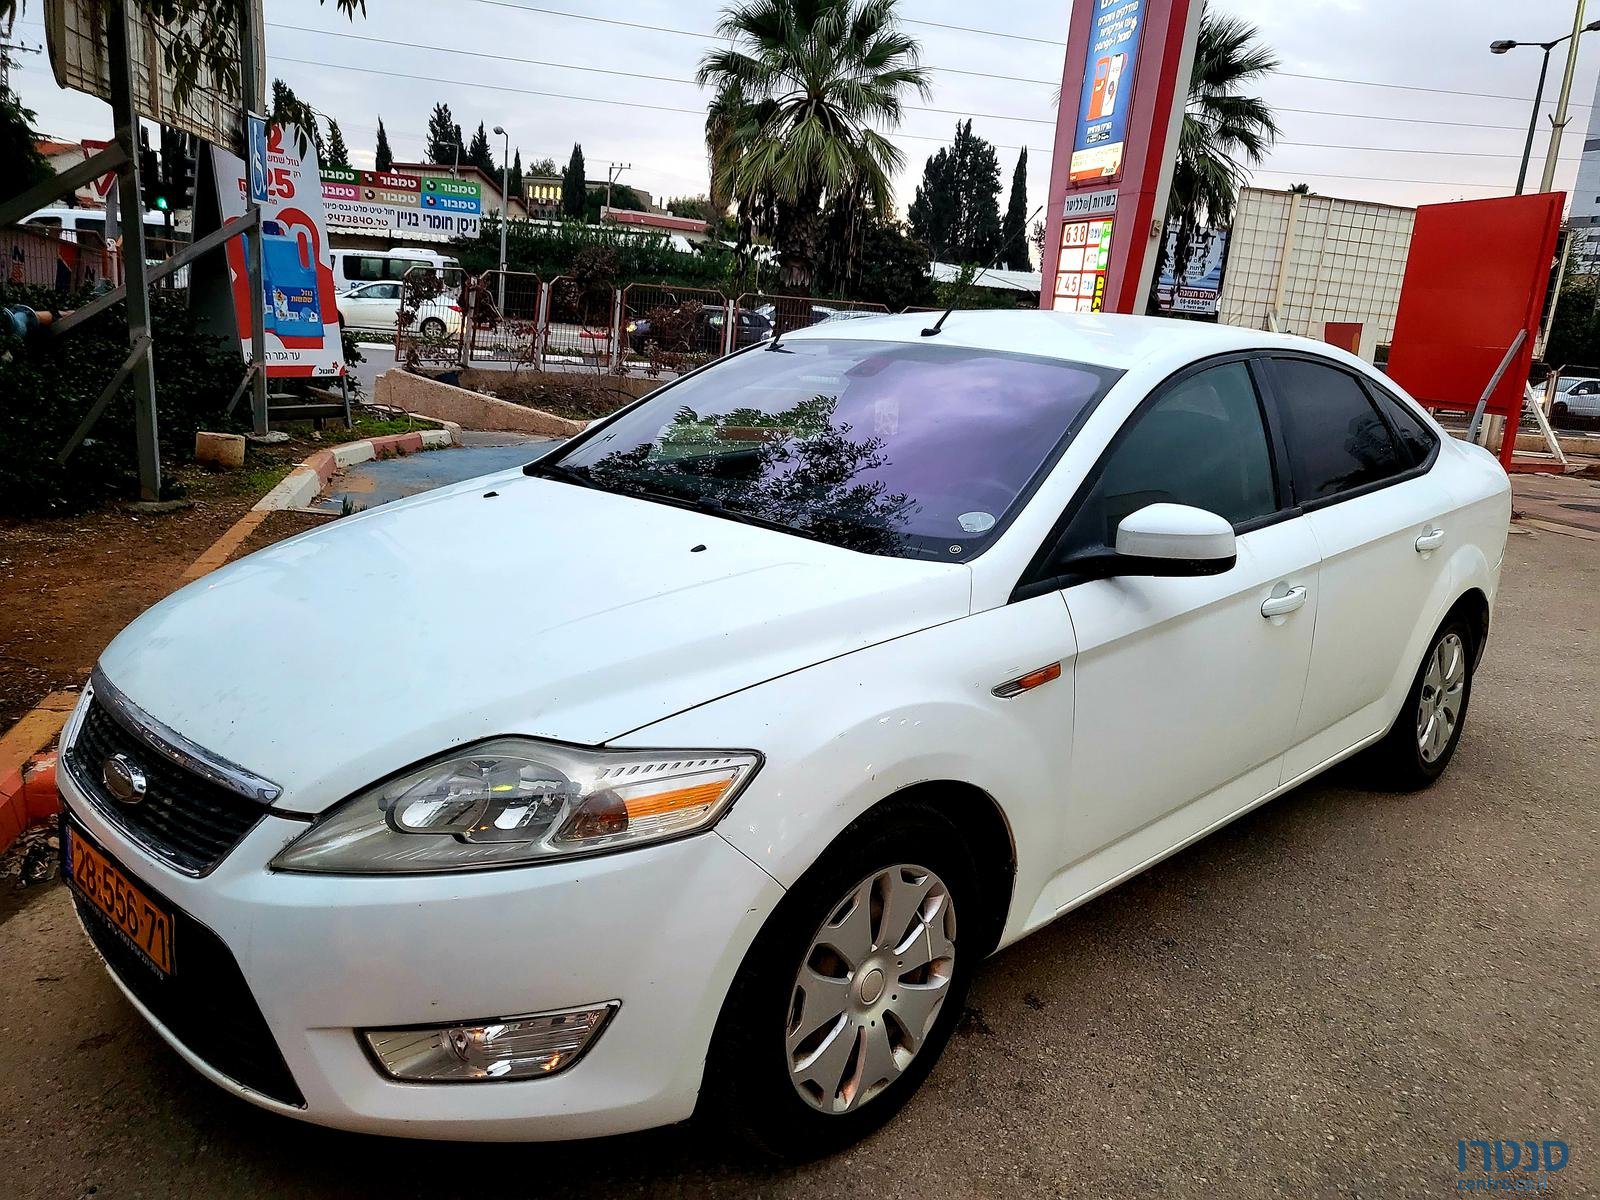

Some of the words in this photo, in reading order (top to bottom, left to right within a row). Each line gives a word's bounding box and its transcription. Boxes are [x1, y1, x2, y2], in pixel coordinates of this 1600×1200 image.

[380, 176, 416, 188] טמבור
[441, 183, 477, 194] טמבור
[380, 192, 416, 203] טמבור
[441, 198, 477, 209] טמבור
[1092, 194, 1116, 209] בשירות
[397, 211, 420, 227] בניין
[423, 214, 452, 230] חומרי
[457, 217, 477, 234] ניסן
[1066, 225, 1086, 243] 638
[1056, 276, 1077, 292] 745
[273, 352, 288, 361] גמר
[290, 352, 300, 360] עד
